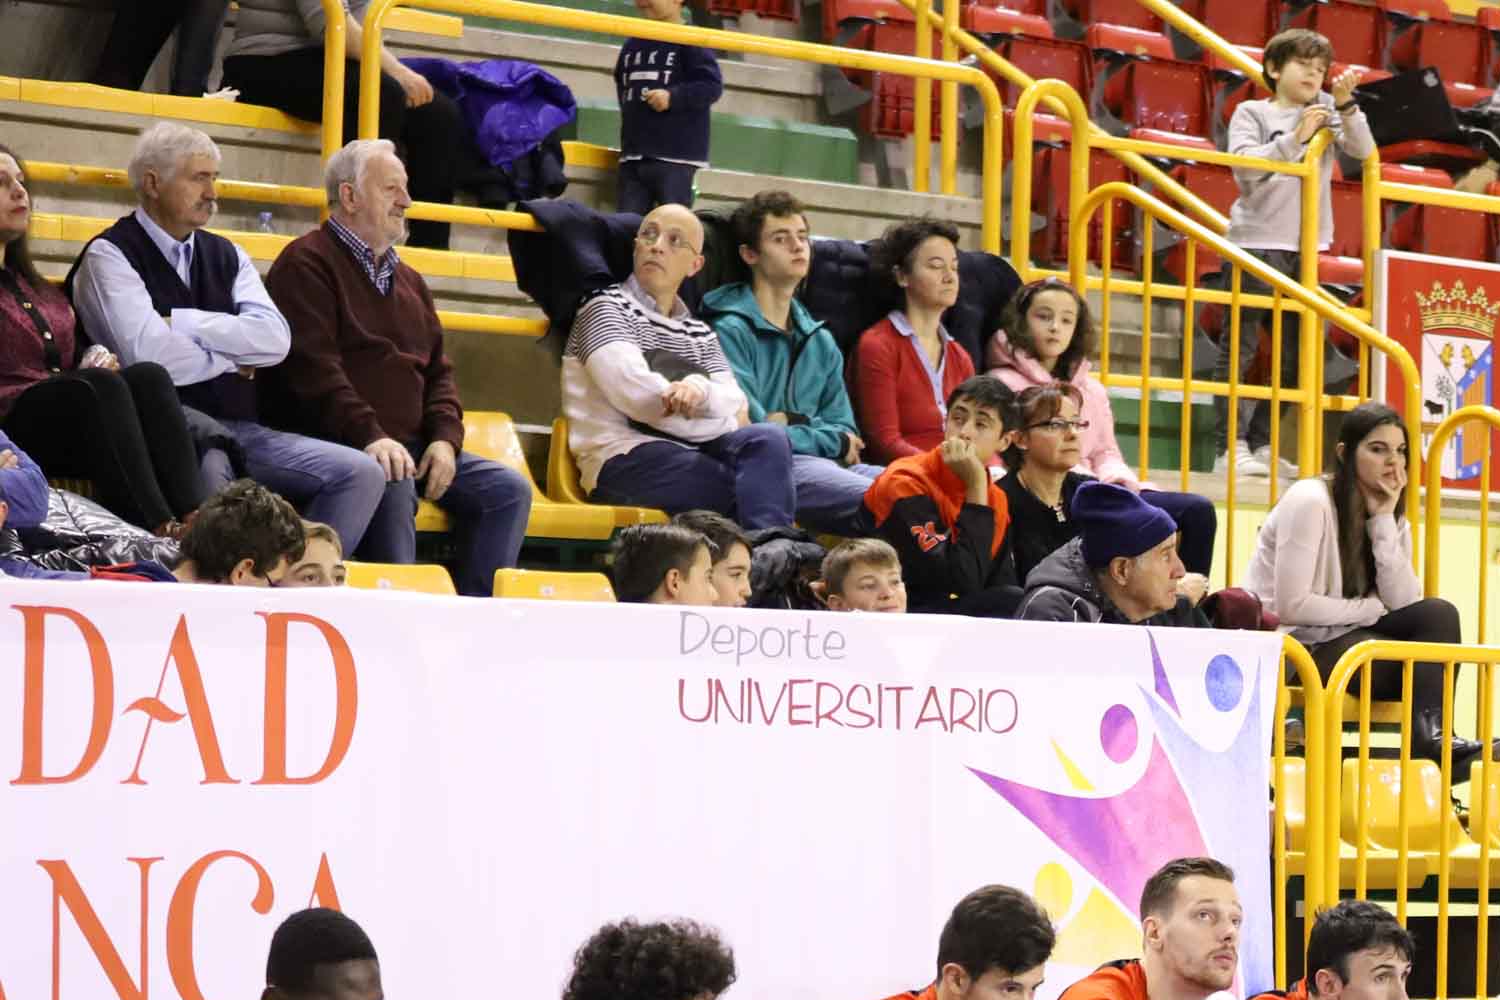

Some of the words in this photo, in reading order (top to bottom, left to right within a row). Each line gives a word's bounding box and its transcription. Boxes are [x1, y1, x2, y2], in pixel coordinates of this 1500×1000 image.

[679, 611, 846, 667] Deporte
[9, 605, 358, 785] DAD
[678, 678, 1018, 734] UNIVERSITARIO
